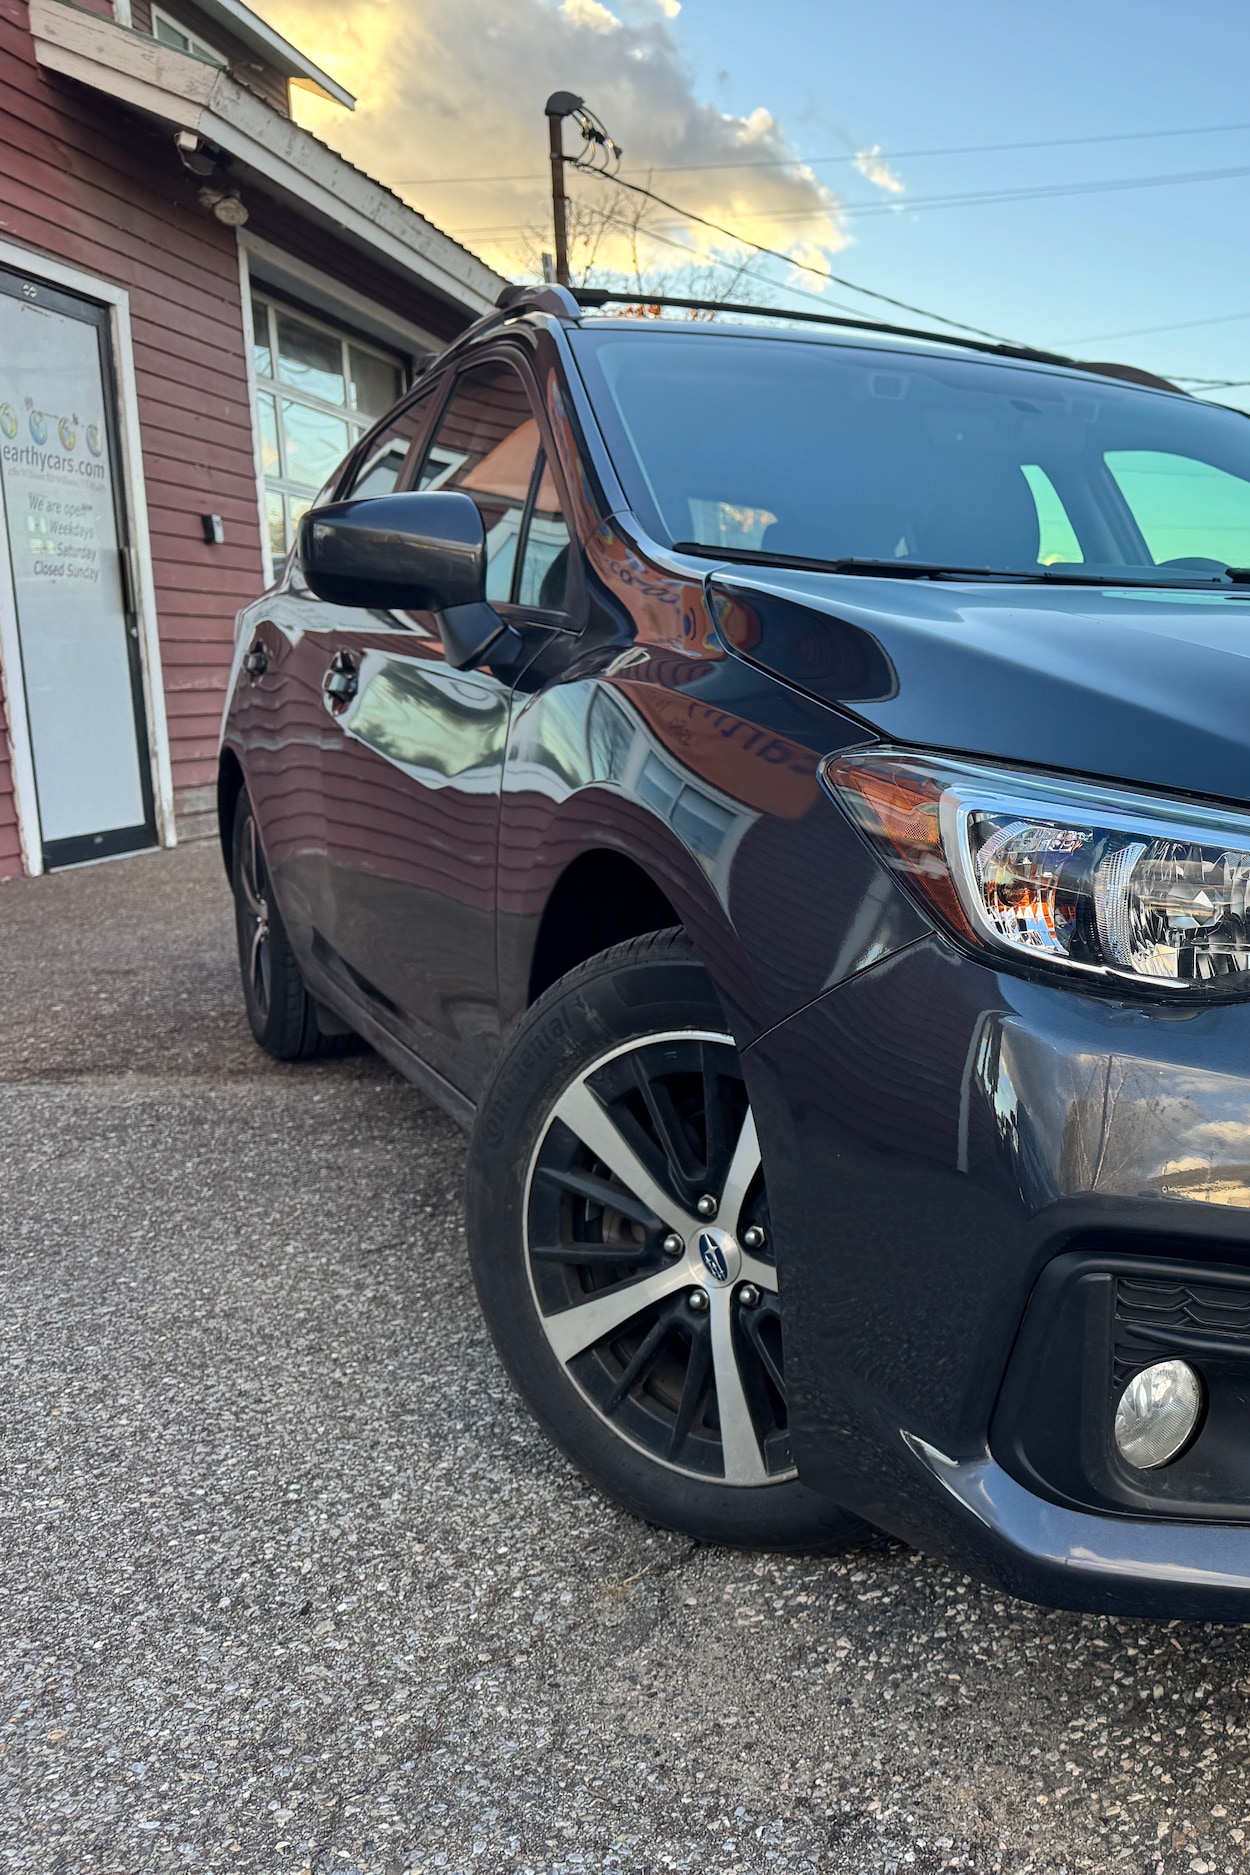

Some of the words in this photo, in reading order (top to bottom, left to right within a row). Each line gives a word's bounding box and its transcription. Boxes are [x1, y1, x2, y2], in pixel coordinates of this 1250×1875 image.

[3, 444, 105, 479] earthycars.com
[29, 492, 44, 511] We
[46, 500, 61, 514] are
[49, 520, 95, 541] Weekdays
[57, 542, 97, 563] Saturday
[34, 560, 65, 577] Closed
[67, 563, 99, 583] Sunday
